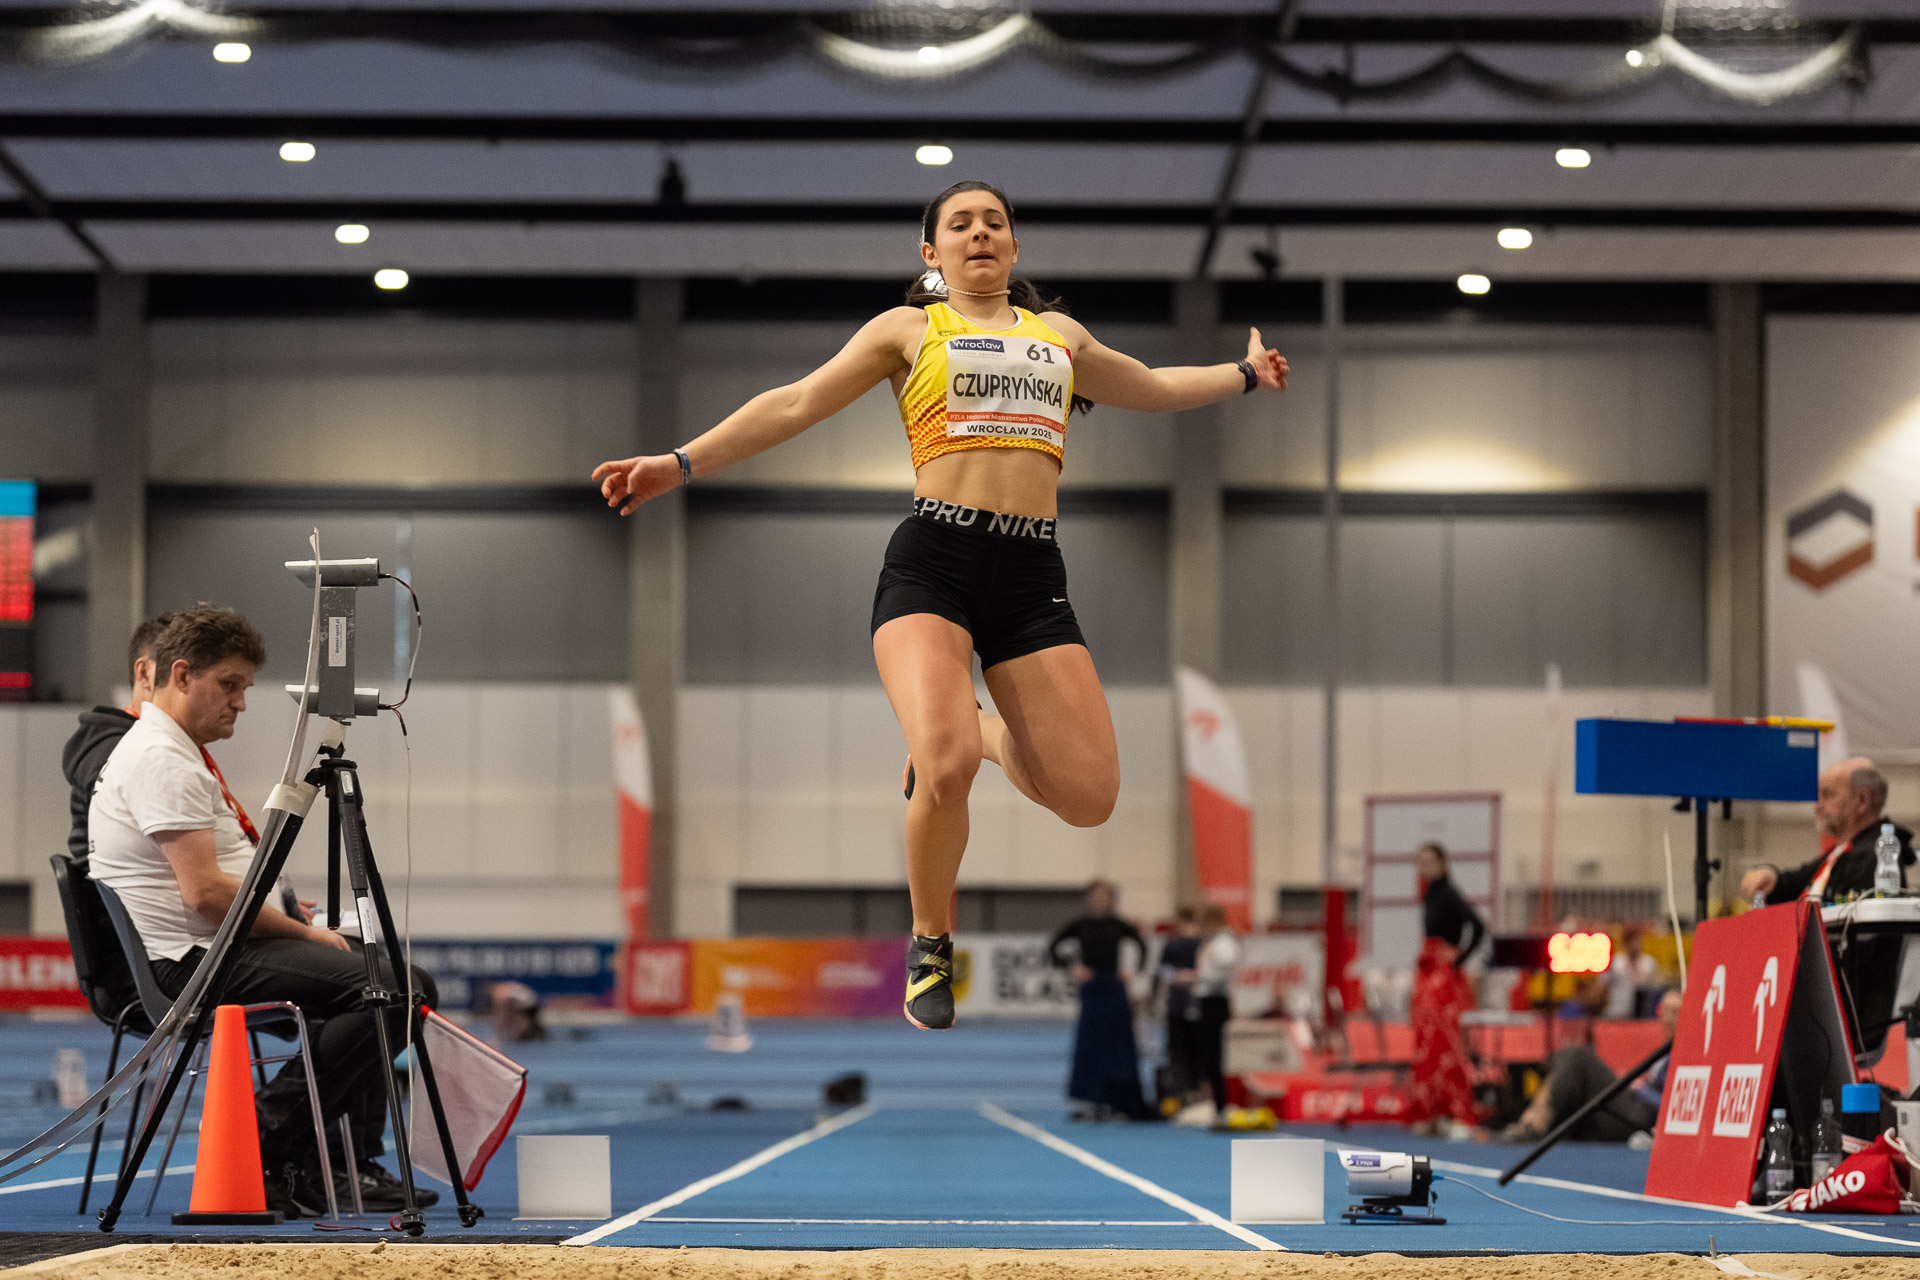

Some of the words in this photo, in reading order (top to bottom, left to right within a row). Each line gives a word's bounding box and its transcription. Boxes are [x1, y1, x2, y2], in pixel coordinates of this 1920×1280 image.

[1026, 344, 1055, 364] 61
[953, 373, 1062, 408] CZUPRYŃSKA
[991, 414, 1028, 422] Mistrzostwa
[967, 425, 1029, 435] WROCŁAW
[1031, 427, 1052, 440] 2025
[919, 497, 979, 527] PRO
[986, 511, 1054, 540] NIKE
[921, 953, 951, 970] NIKE
[1671, 1076, 1707, 1122] ORLEN
[1720, 1076, 1759, 1125] ORLEN
[1809, 1170, 1866, 1209] JAKO
